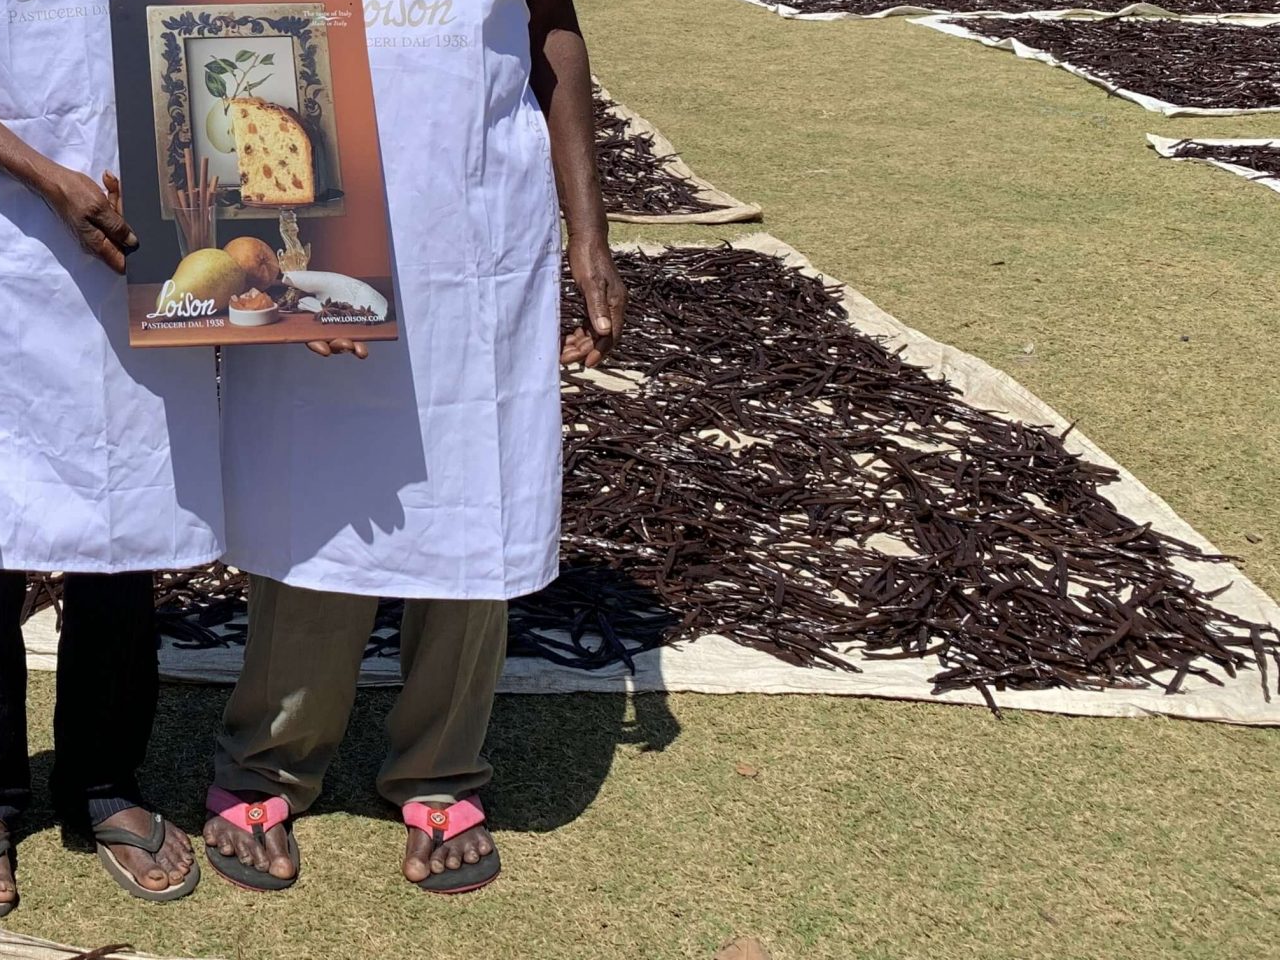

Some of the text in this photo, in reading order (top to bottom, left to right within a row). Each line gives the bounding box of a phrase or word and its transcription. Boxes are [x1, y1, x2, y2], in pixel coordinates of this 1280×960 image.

[7, 4, 109, 24] PASTICCERI DA
[338, 10, 352, 18] Italy
[402, 37, 431, 48] DAL
[434, 34, 469, 49] 1938
[146, 279, 218, 319] Loison
[141, 321, 186, 330] PASTICCERI
[206, 319, 225, 328] 1938
